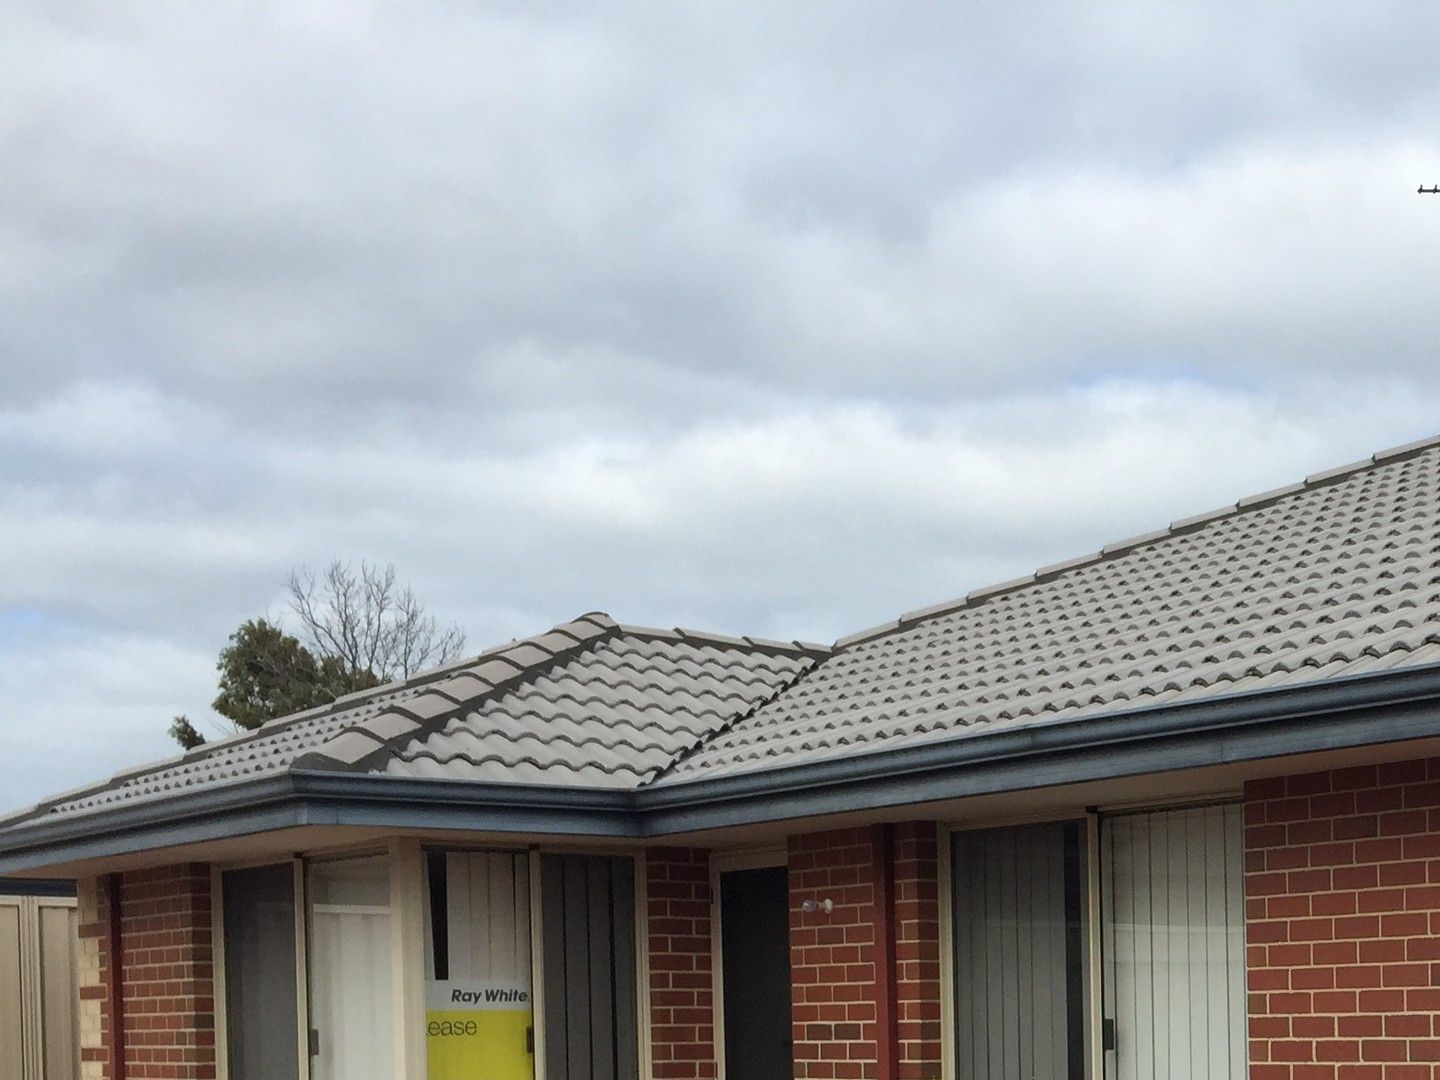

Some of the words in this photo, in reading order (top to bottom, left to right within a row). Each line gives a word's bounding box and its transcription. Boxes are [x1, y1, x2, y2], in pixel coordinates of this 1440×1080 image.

[451, 989, 482, 1005] Ray
[485, 989, 529, 1003] White
[426, 1020, 478, 1036] ease
